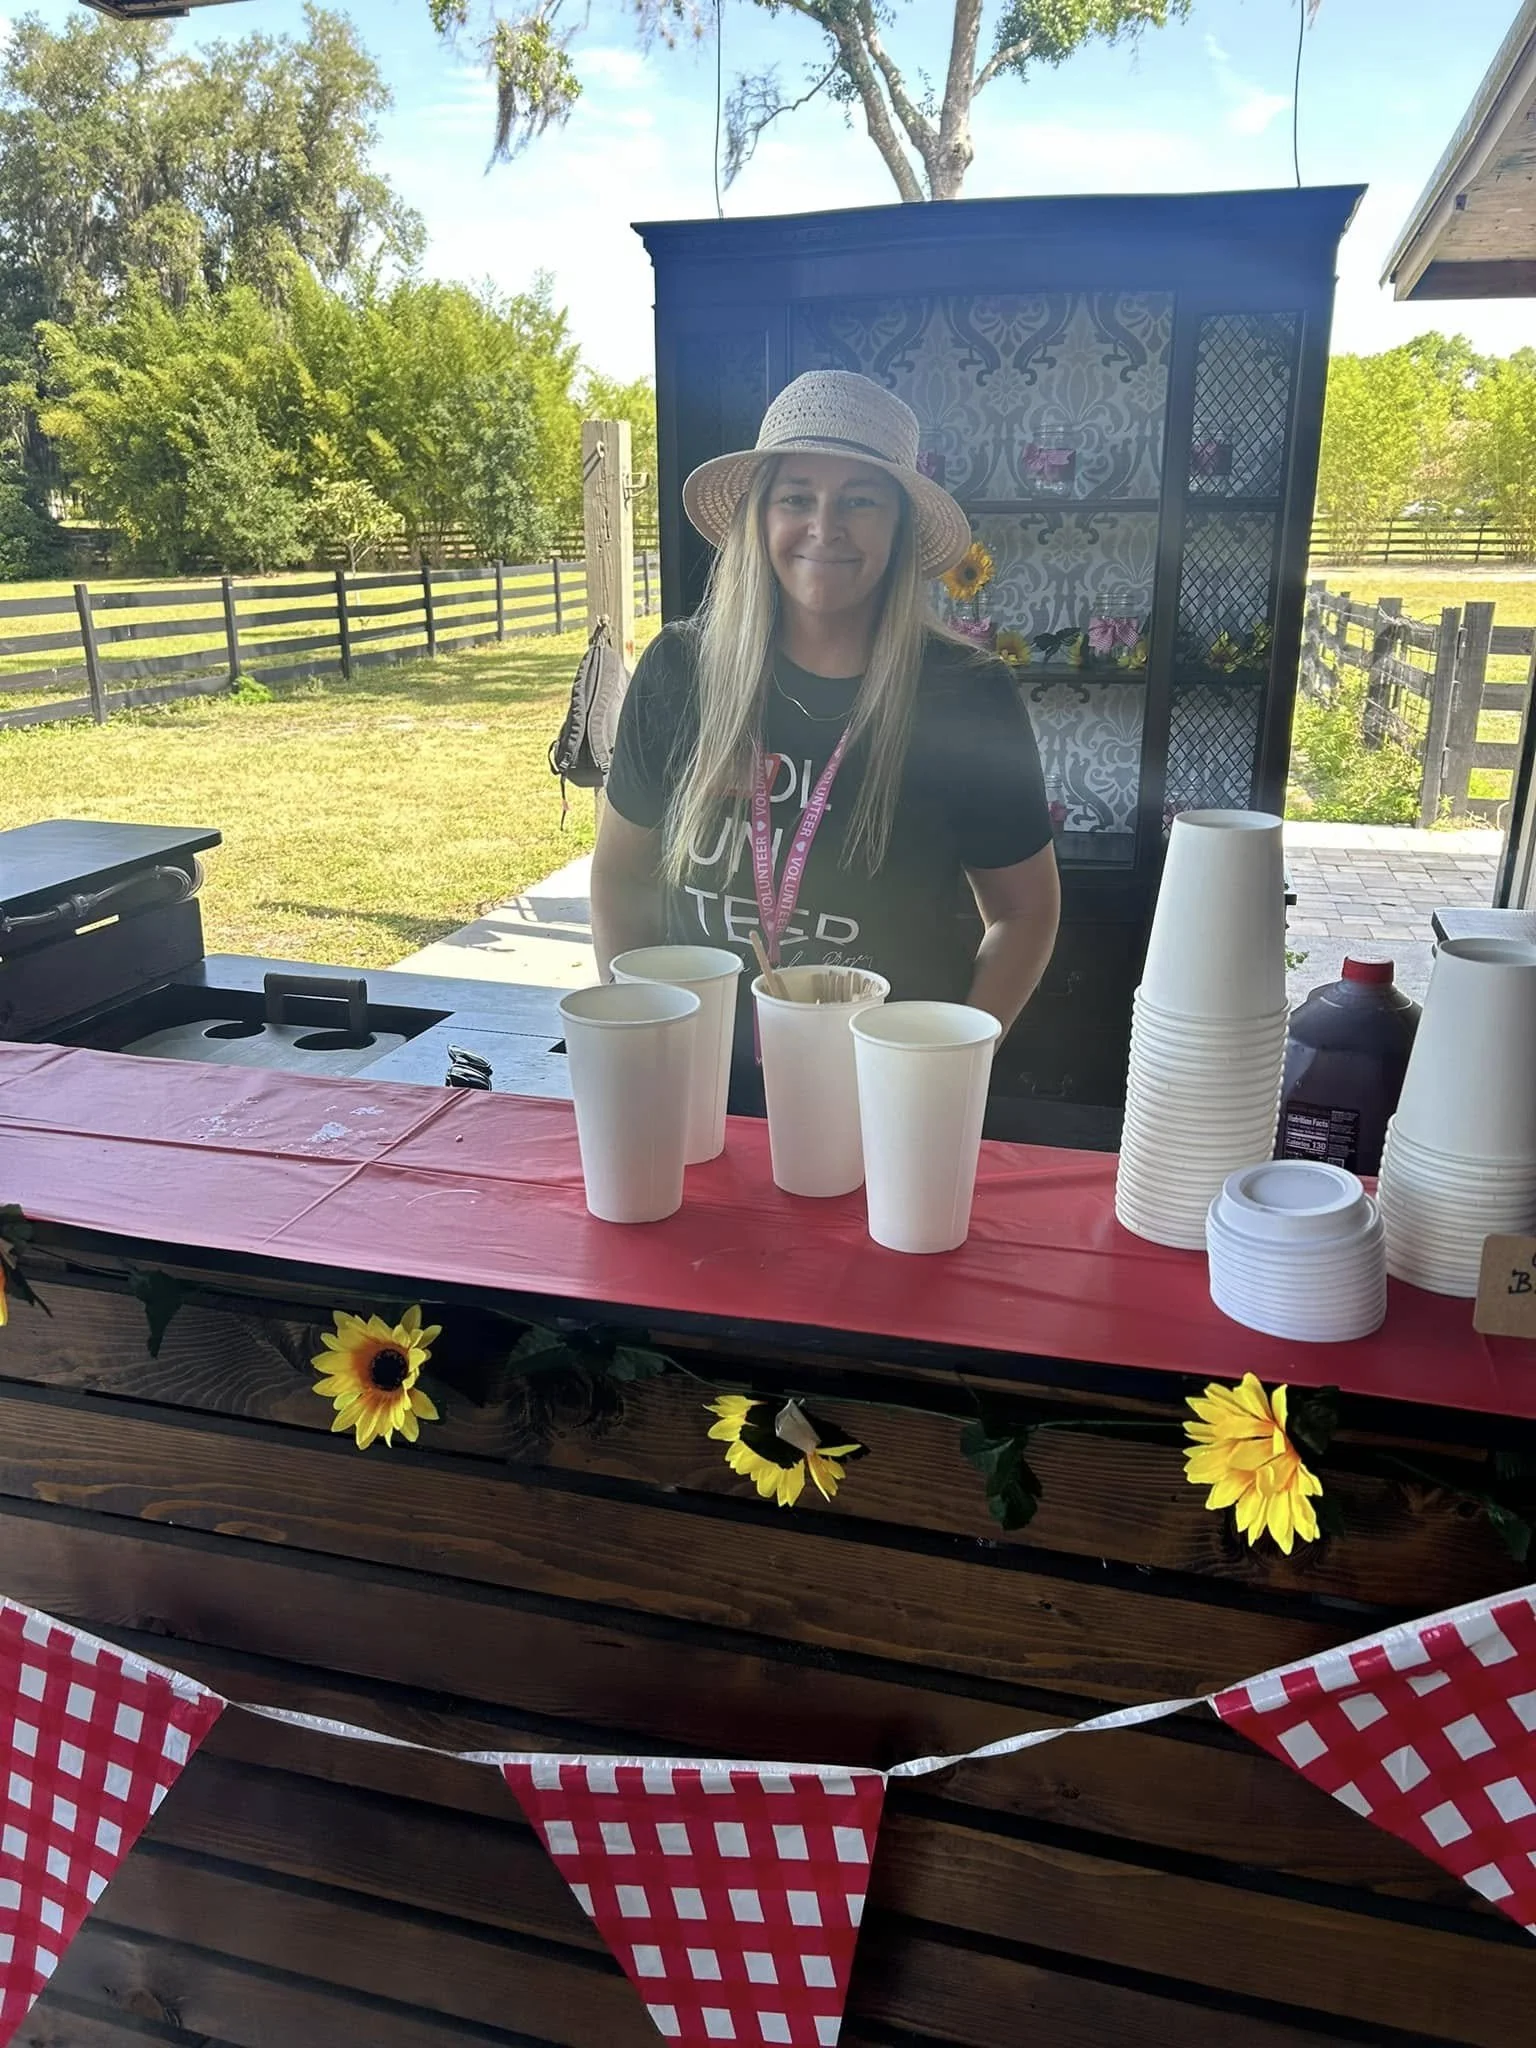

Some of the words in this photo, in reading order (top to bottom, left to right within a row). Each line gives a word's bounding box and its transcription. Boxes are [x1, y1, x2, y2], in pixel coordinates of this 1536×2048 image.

[800, 762, 837, 838] VOLUNTEER
[755, 836, 773, 917] VOLUNTEER
[776, 856, 803, 933] VOLUNTEER
[1312, 1141, 1327, 1150] 130
